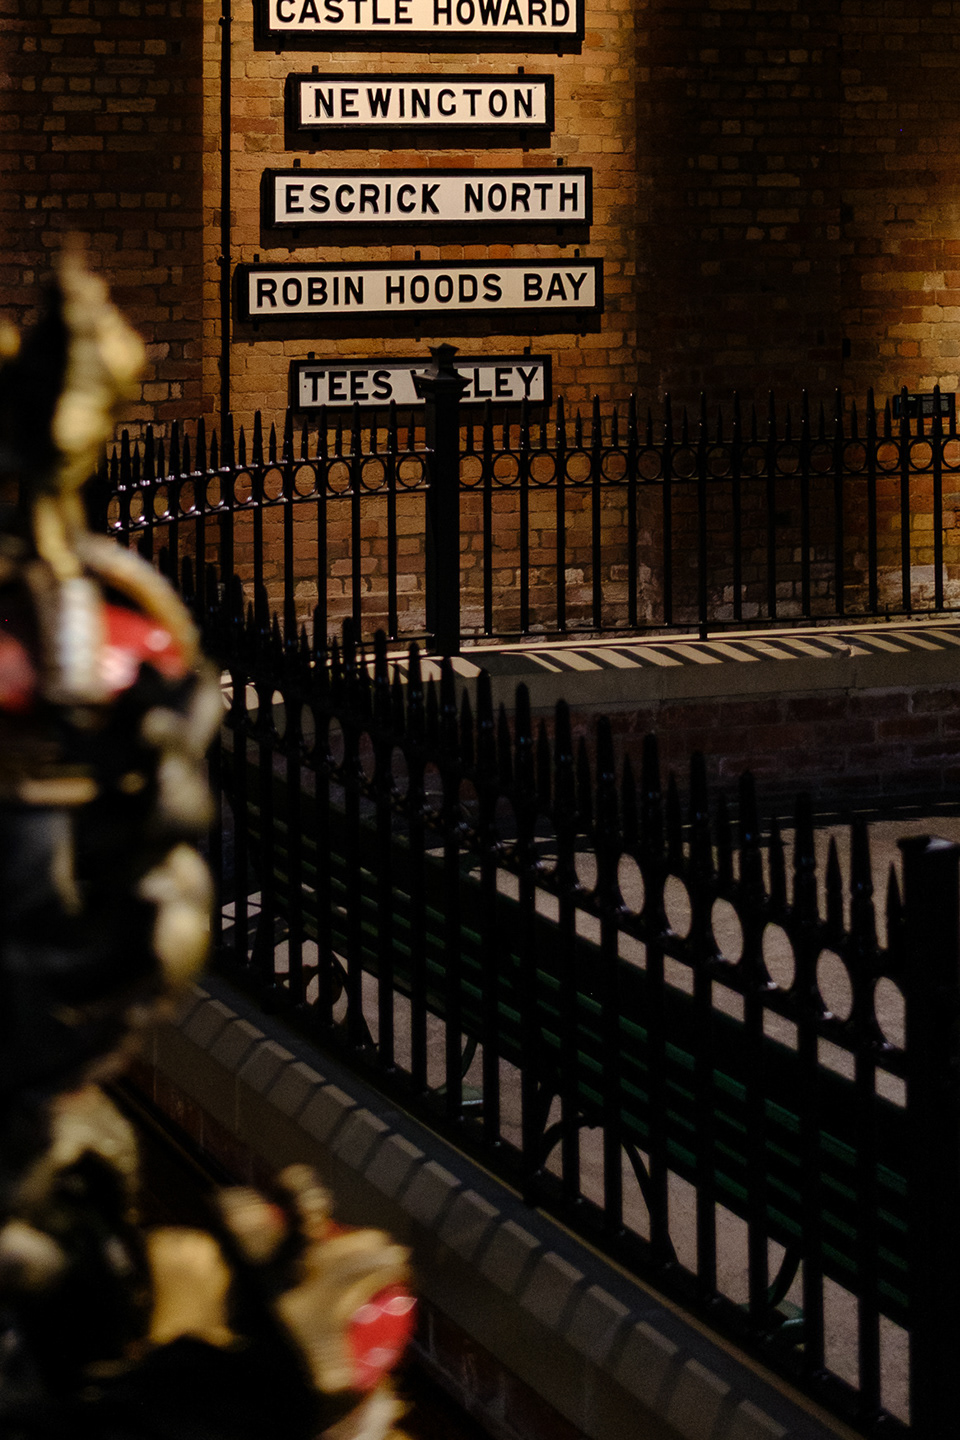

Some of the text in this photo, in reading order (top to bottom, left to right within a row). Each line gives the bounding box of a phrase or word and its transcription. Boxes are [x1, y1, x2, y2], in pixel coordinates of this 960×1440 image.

[313, 87, 534, 118] NEWINGTON
[285, 182, 579, 214] ESCRICK NORTH
[256, 272, 588, 308] ROBIN HOODS BAY
[304, 370, 394, 402] TEES
